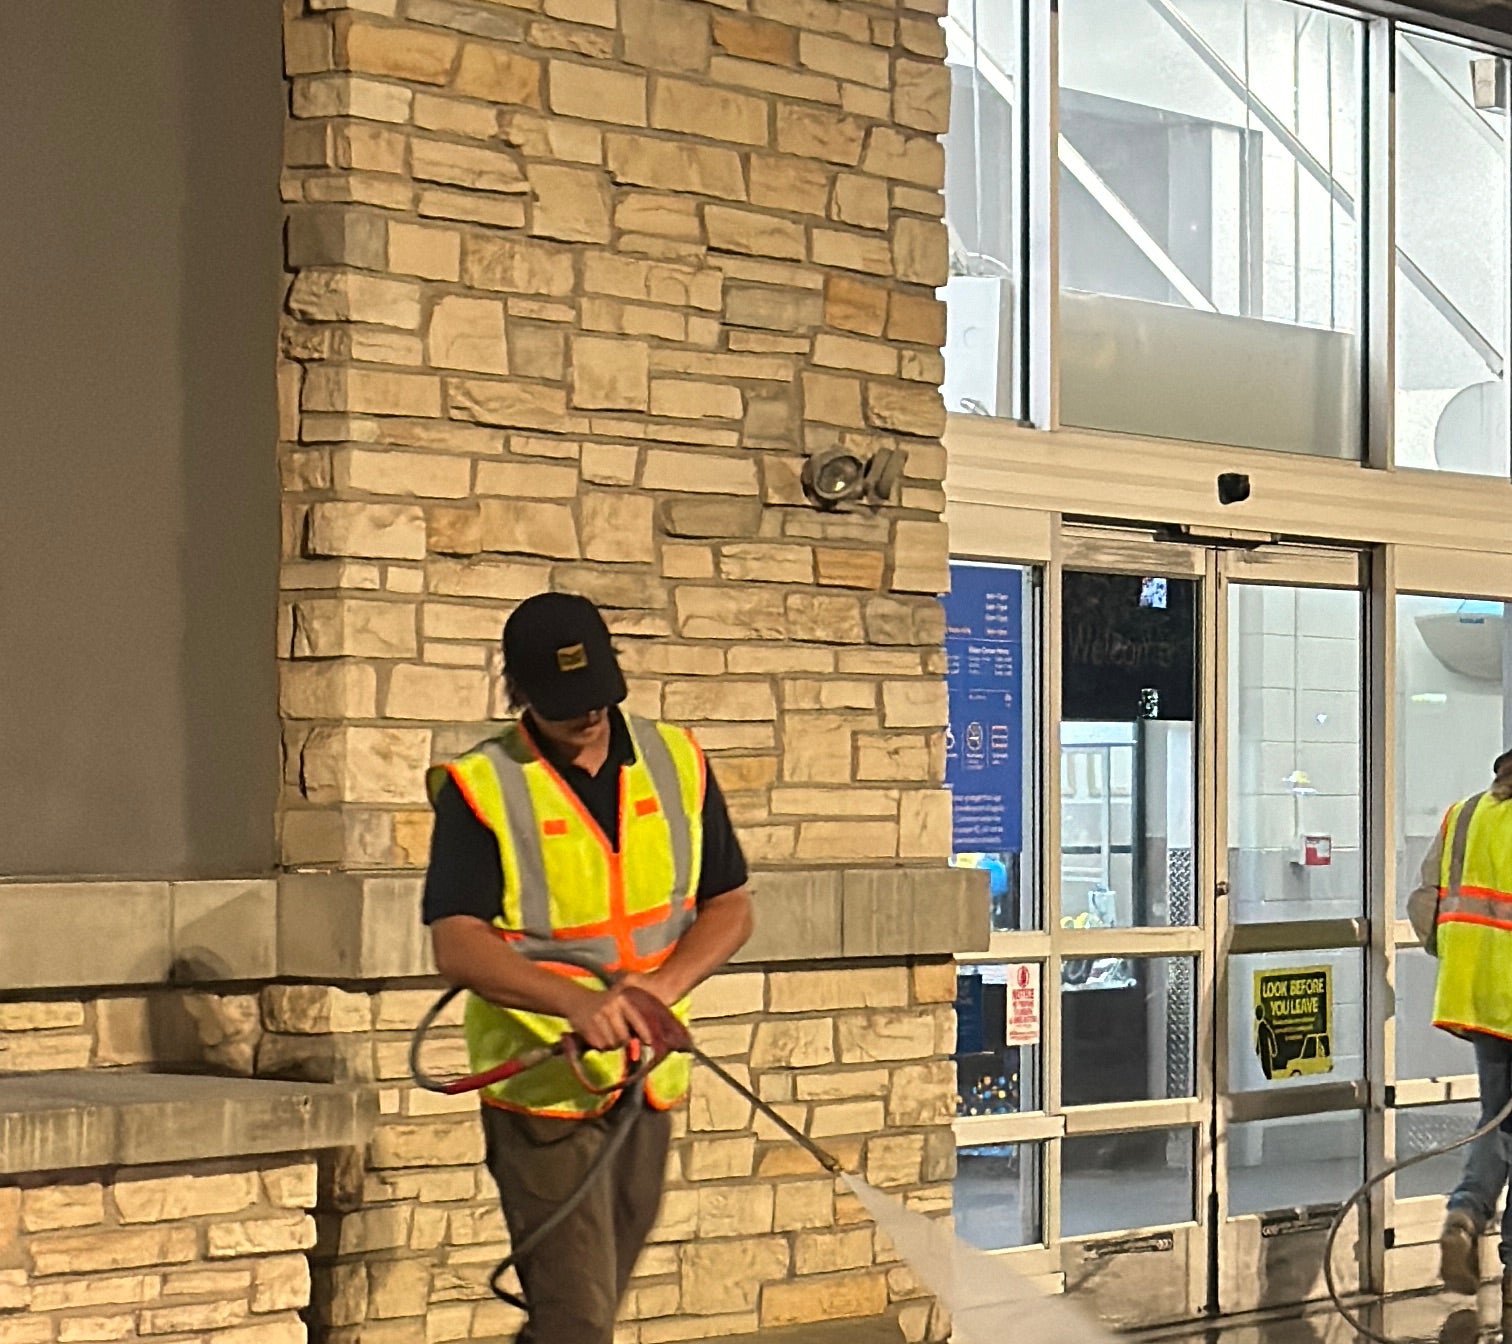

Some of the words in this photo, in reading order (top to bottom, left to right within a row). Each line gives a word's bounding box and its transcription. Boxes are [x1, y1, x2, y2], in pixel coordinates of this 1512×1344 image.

[1262, 981, 1288, 998] LOOK
[1289, 978, 1325, 996] BEFORE
[1270, 1000, 1290, 1016] YOU
[1291, 997, 1319, 1014] LEAVE
